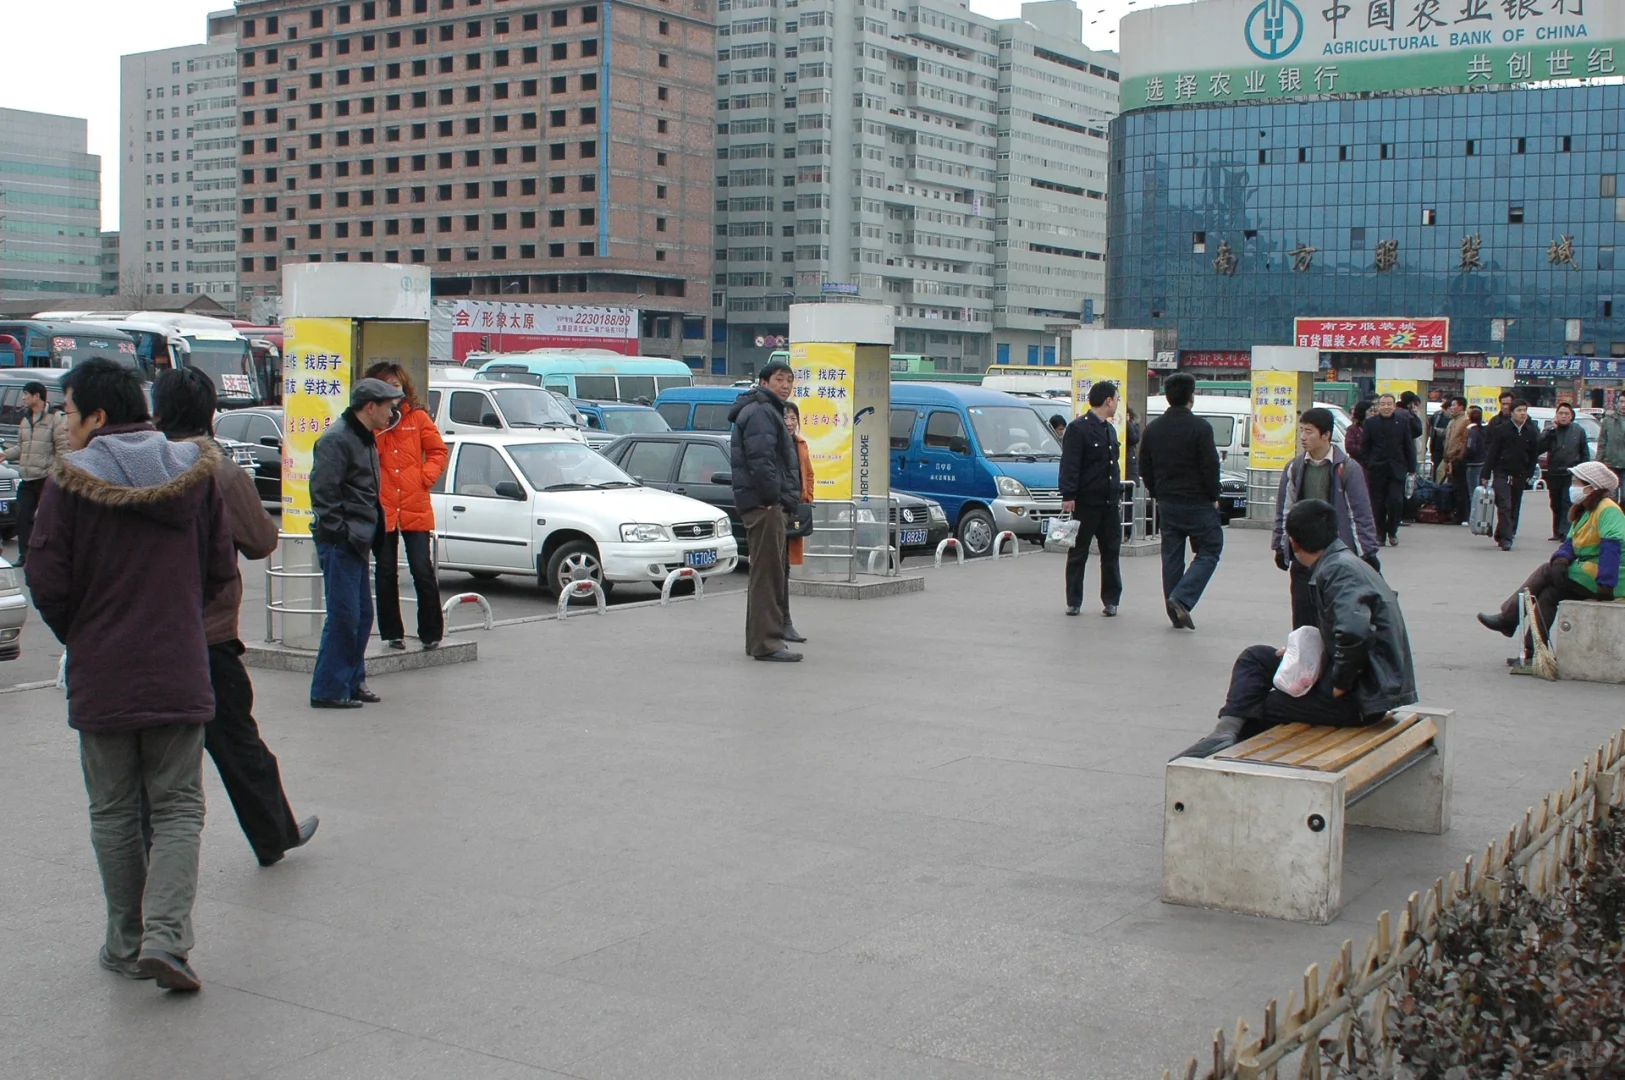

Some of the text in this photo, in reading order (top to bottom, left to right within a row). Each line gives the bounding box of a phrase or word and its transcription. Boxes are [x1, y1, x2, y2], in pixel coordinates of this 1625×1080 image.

[1322, 23, 1588, 56] AGRICULTURAL BANK OF CHINA
[1144, 47, 1616, 102] 选择农业银行 共创世纪
[1211, 231, 1580, 277] 南方服装城
[575, 313, 631, 326] 2230188/99
[1320, 322, 1417, 331] 南方服装城
[1298, 334, 1443, 348] 百货服装大展销 2 元起
[305, 354, 341, 370] 找房子
[1487, 356, 1515, 369] 平价
[818, 369, 846, 381] 找房子
[304, 379, 341, 396] 学技术
[817, 387, 846, 399] 学技术
